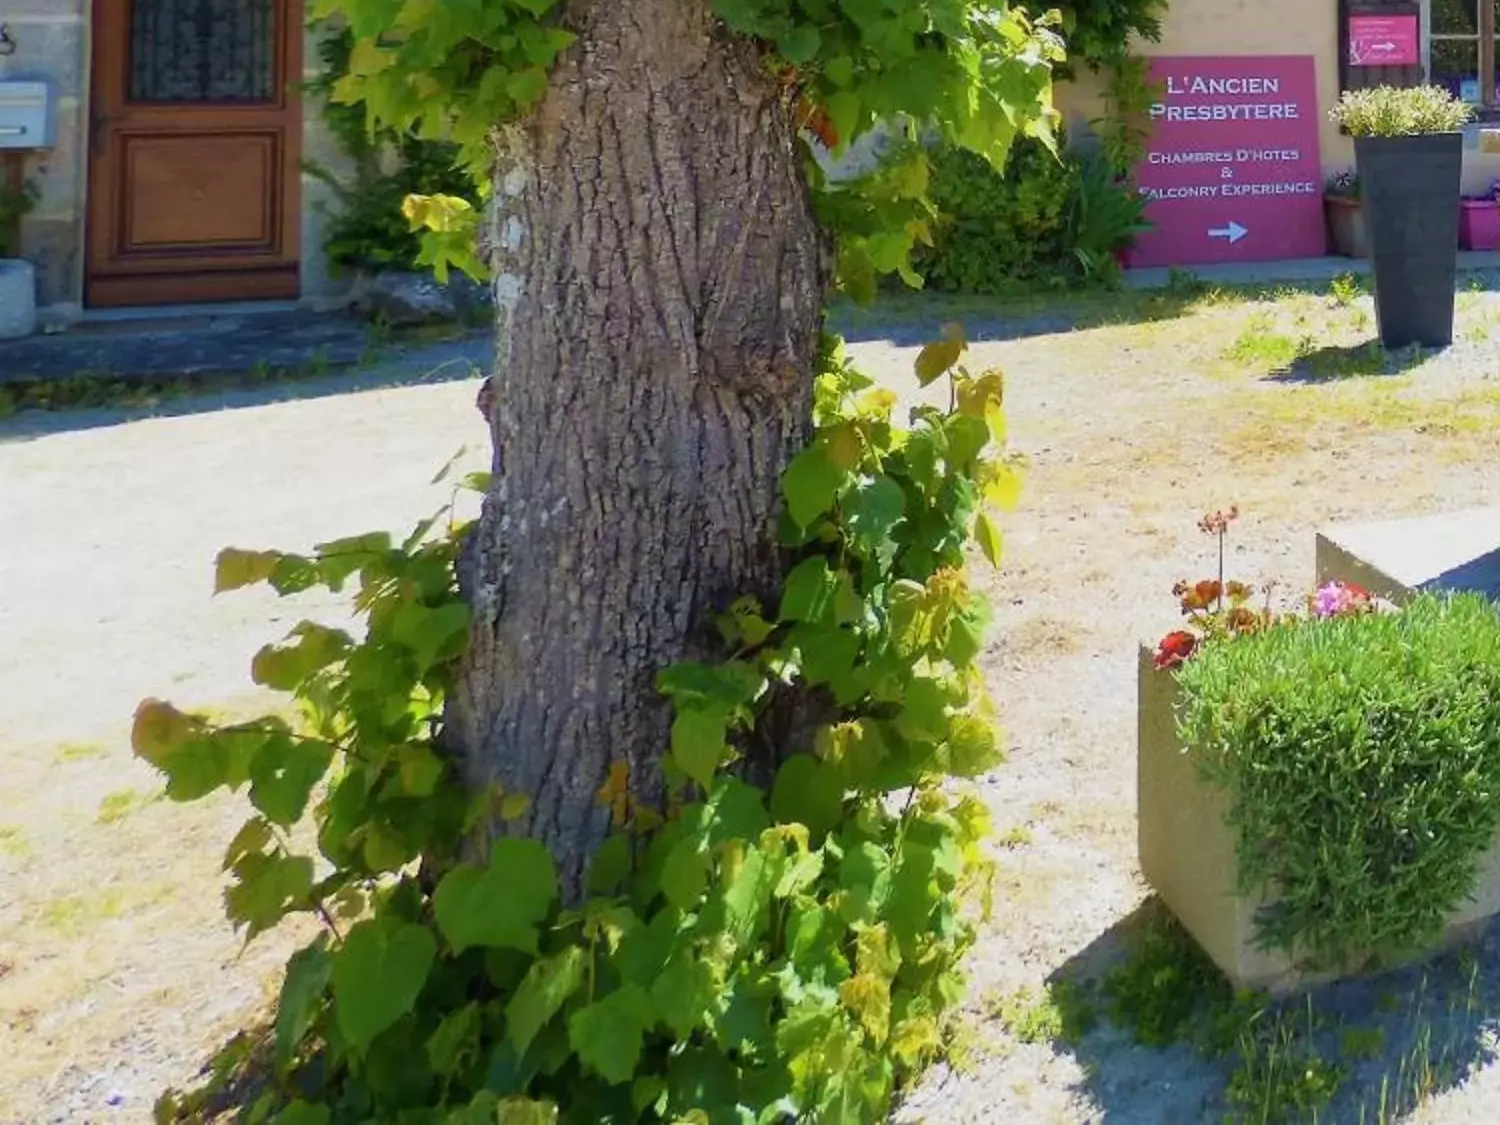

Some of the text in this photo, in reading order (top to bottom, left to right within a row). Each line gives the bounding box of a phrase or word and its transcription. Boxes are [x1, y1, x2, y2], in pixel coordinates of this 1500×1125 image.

[1167, 76, 1279, 94] L'ANCIEN
[1149, 152, 1232, 164] CHAMBRES
[1220, 166, 1233, 178] &
[1221, 182, 1315, 196] EXPERIENCE
